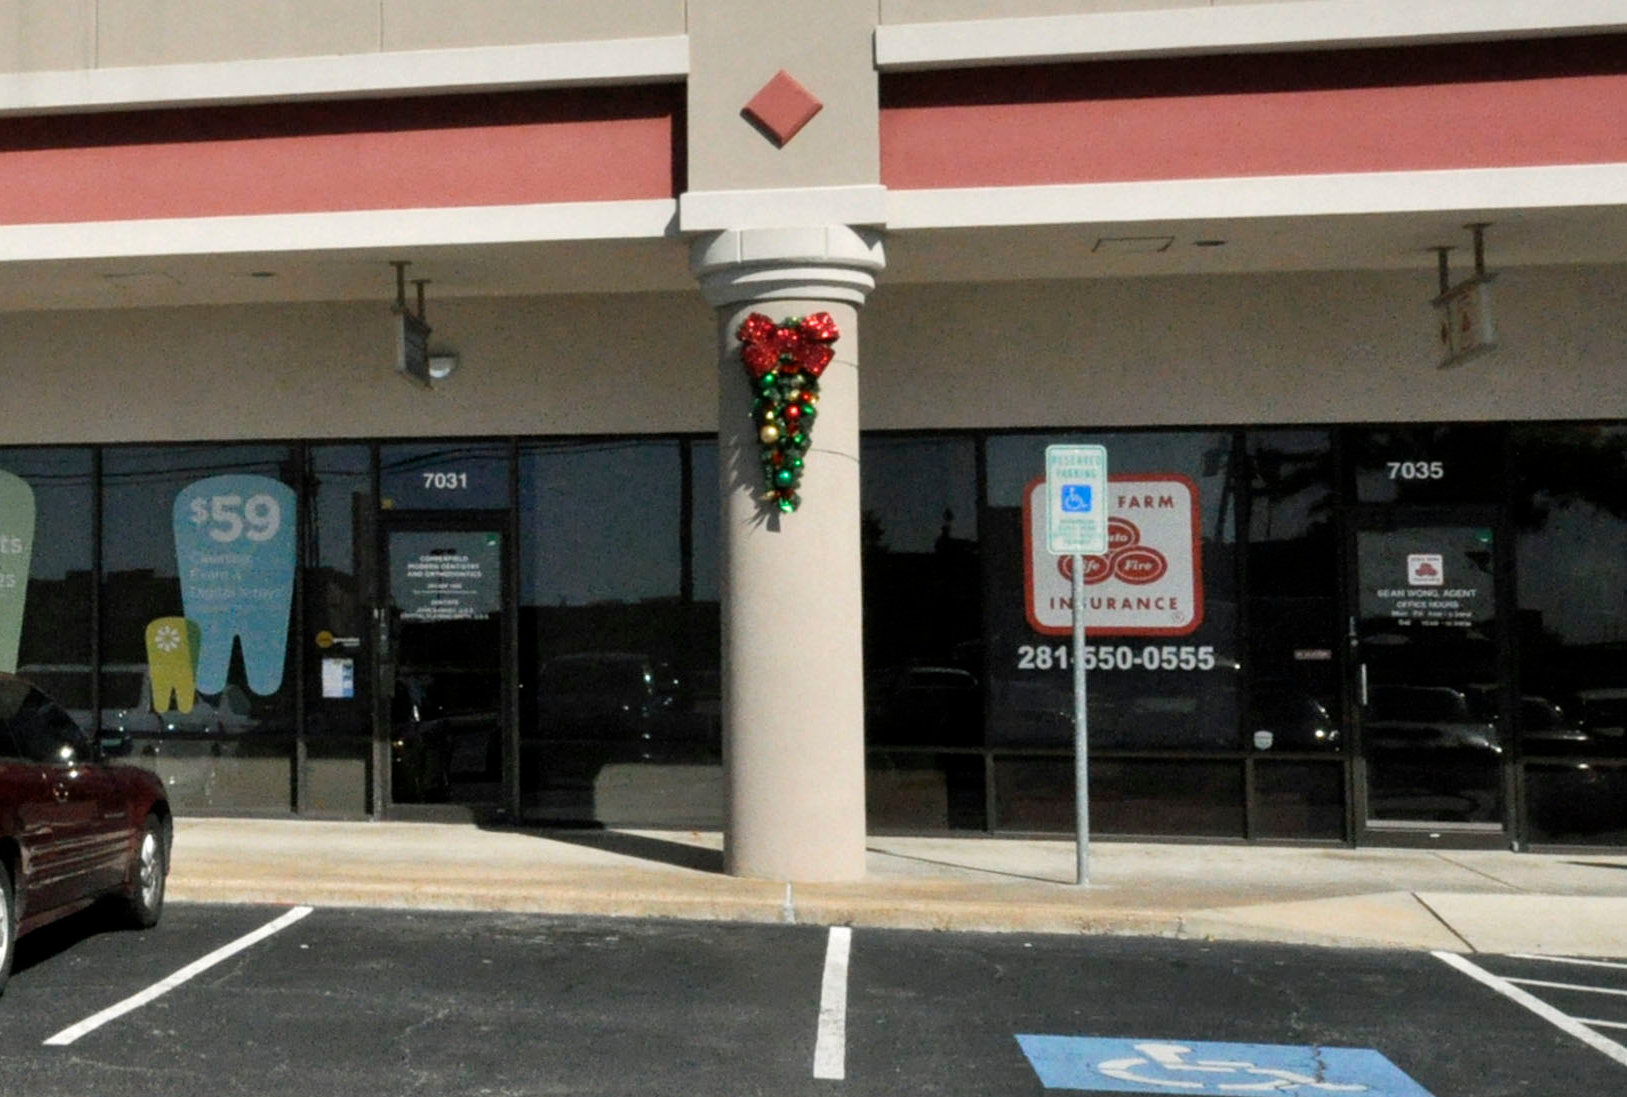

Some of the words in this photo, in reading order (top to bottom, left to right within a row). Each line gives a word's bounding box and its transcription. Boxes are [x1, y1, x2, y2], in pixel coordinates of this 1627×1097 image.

[1386, 461, 1444, 479] 7035
[423, 471, 467, 489] 7031
[1117, 495, 1174, 509] FARM
[190, 494, 280, 542] $59
[1124, 559, 1153, 571] Fire
[1049, 596, 1179, 610] INURANCE
[1017, 645, 1215, 670] 281550-0555
